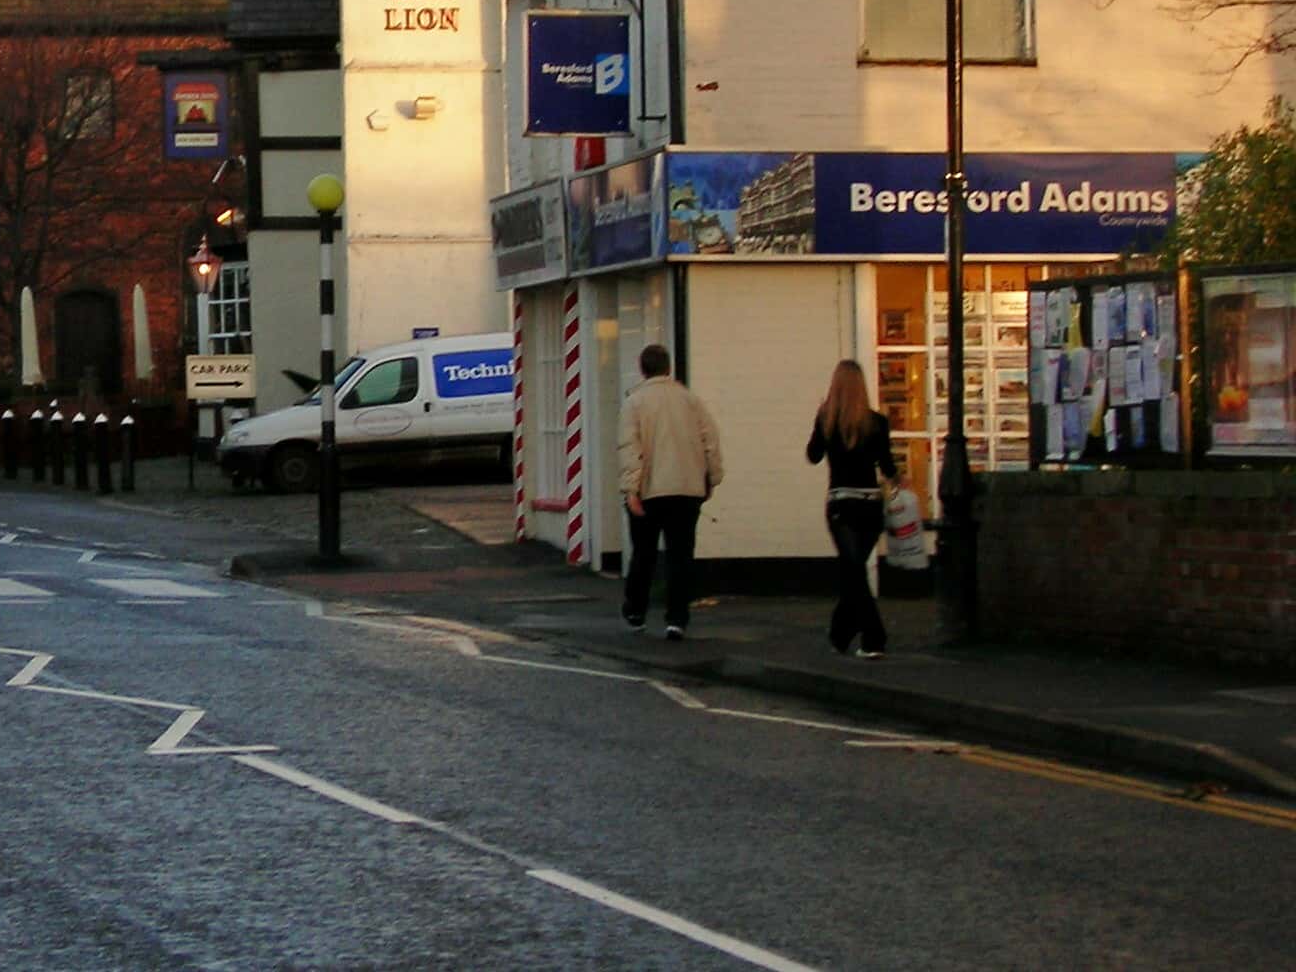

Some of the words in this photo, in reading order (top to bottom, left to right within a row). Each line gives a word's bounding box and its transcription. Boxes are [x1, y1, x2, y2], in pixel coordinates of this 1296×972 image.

[384, 8, 460, 32] LION
[850, 181, 1030, 213] Beresord
[1039, 181, 1169, 213] Adams
